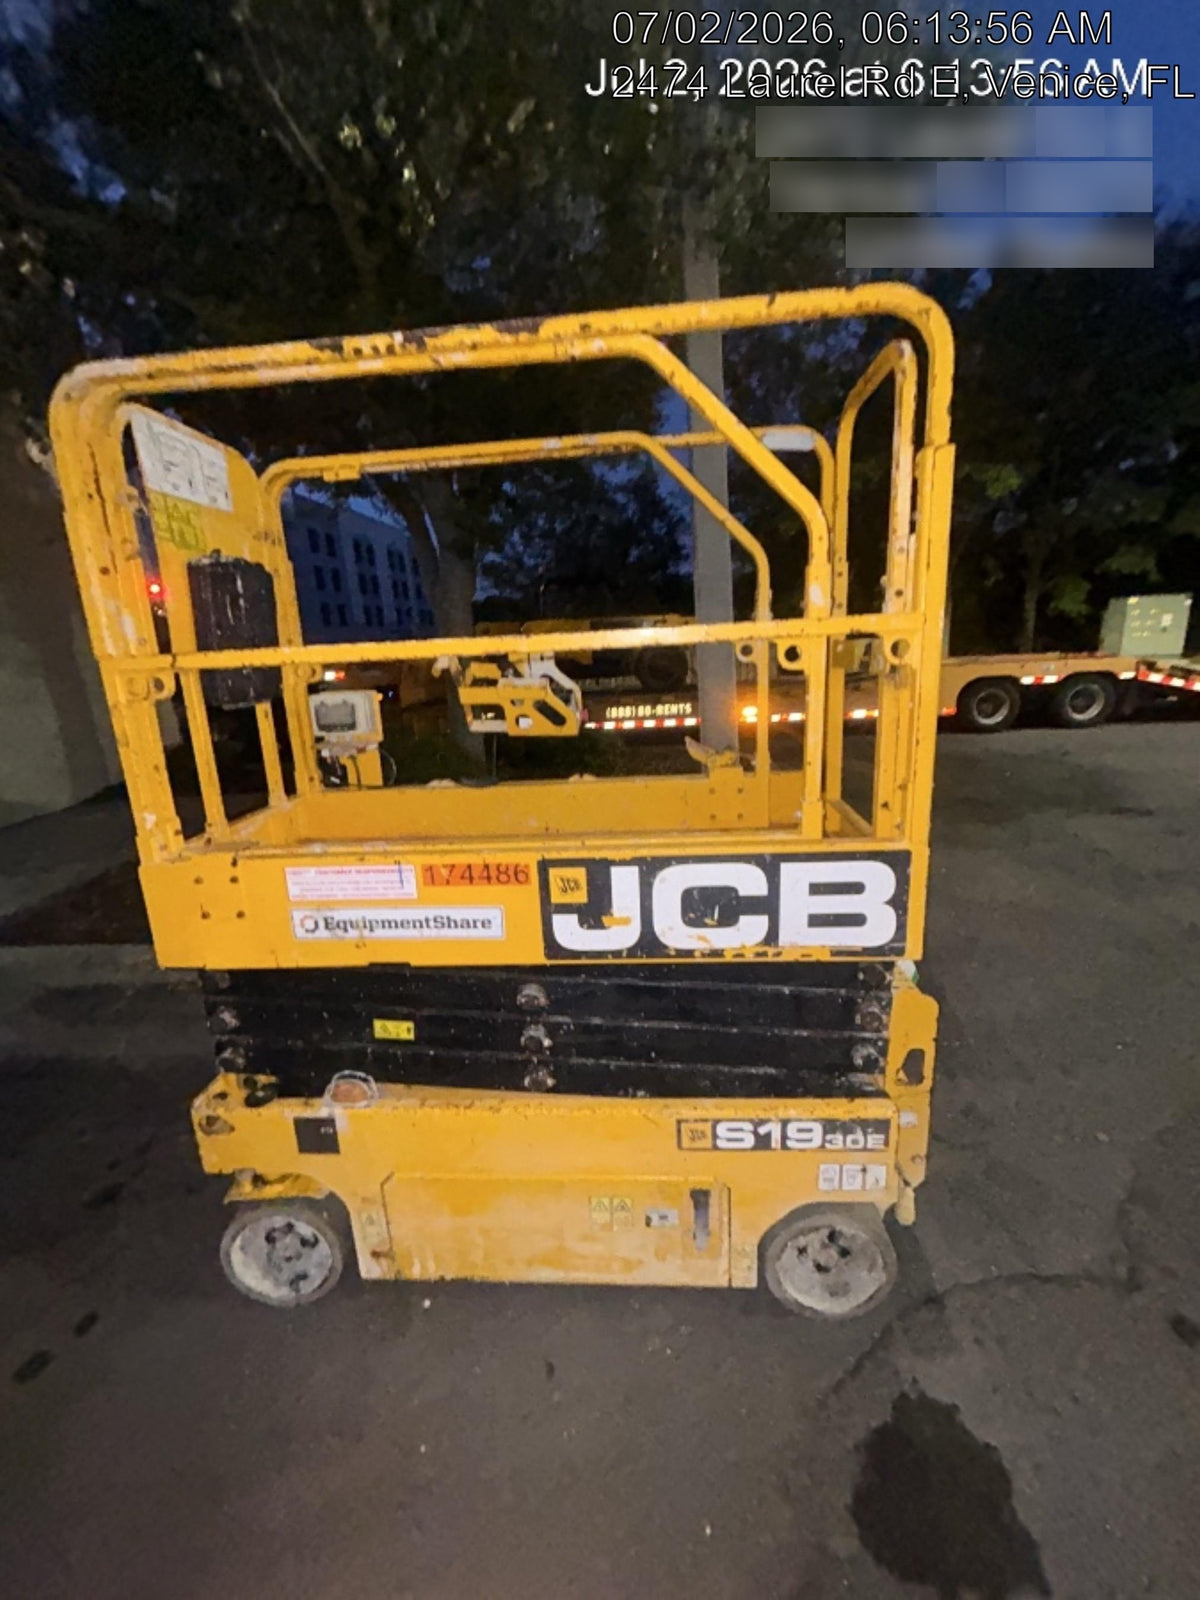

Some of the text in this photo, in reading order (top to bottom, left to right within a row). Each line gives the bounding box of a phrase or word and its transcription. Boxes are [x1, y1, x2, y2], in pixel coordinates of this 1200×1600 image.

[423, 863, 529, 885] 174486
[552, 861, 896, 952] JCB
[323, 915, 492, 933] EquipmentShare
